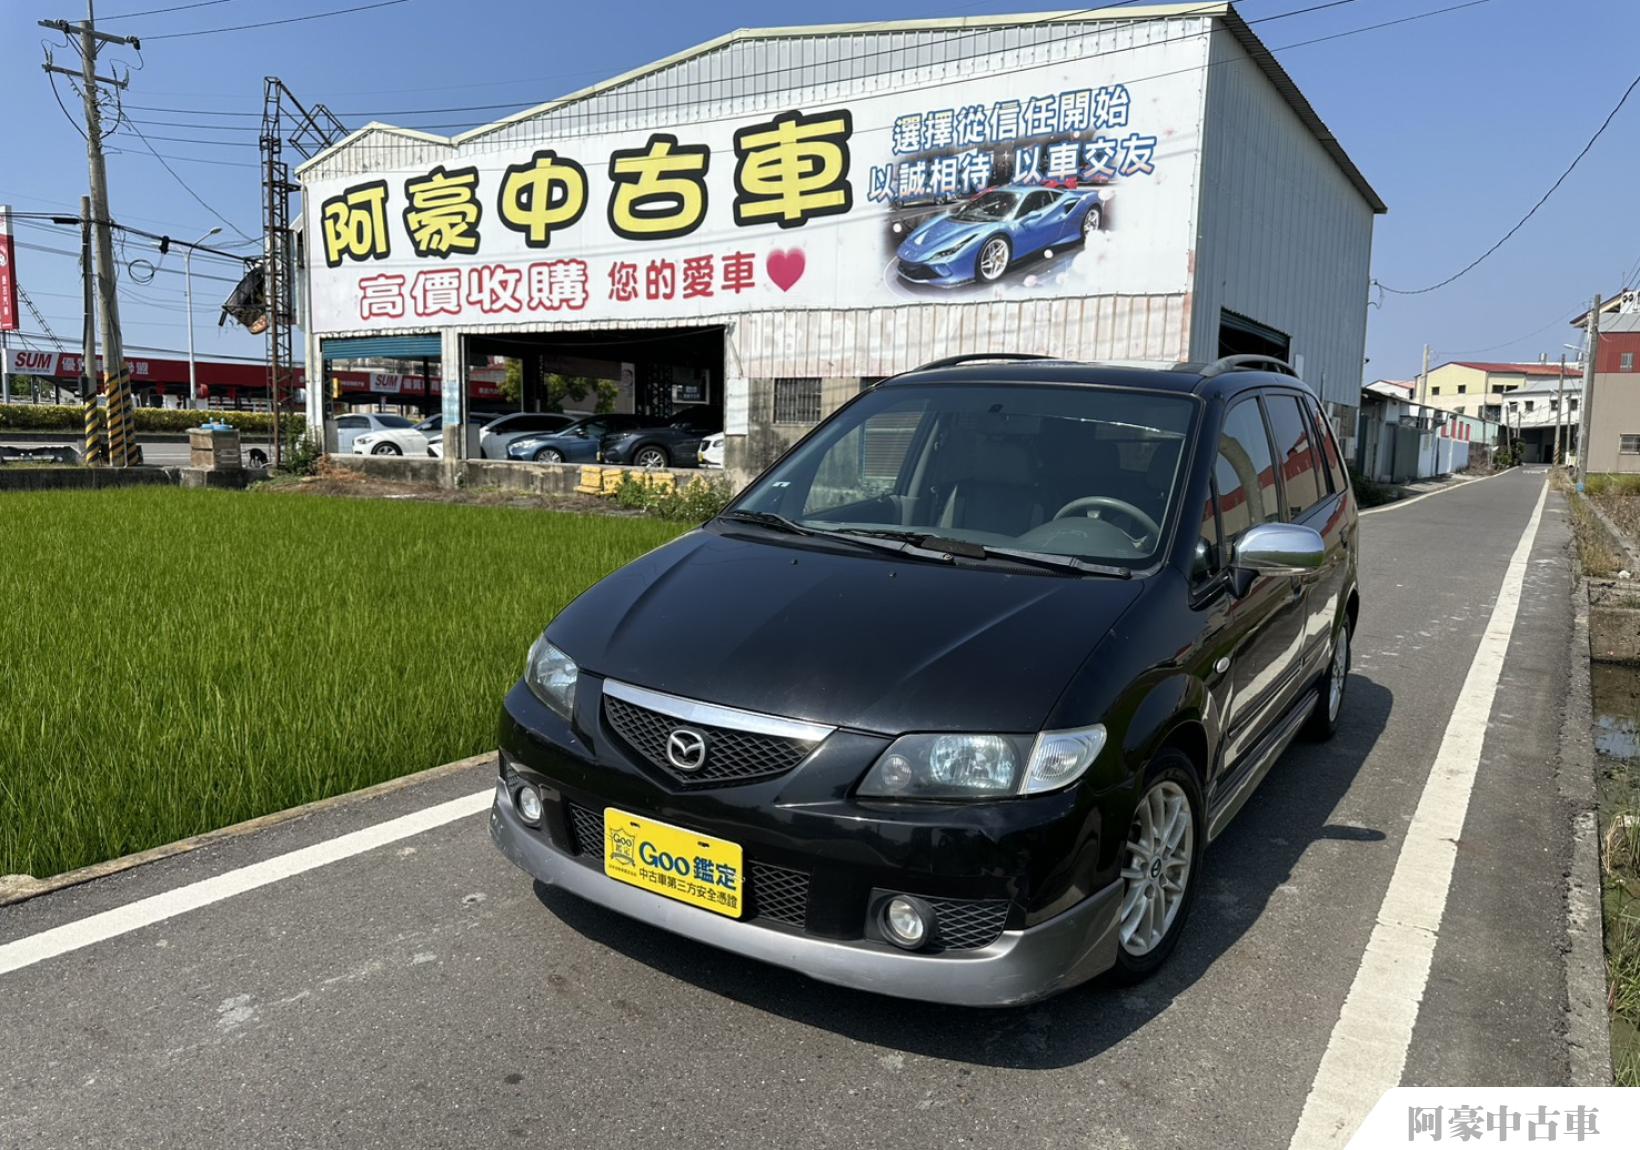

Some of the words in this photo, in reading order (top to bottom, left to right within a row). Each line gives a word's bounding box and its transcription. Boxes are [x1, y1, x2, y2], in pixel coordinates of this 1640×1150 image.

[892, 84, 1131, 155] 選擇從信任開始
[321, 110, 853, 267] 阿豪中古車
[867, 154, 991, 201] 以誠相待
[1011, 134, 1156, 185] 以車交友
[358, 258, 590, 320] 高價收購
[607, 250, 756, 301] 您的愛車
[15, 351, 52, 369] SUM
[375, 374, 398, 386] SUM
[613, 833, 632, 847] Goo
[639, 841, 690, 876] Goo
[693, 856, 737, 891] 鑑定
[639, 867, 737, 908] 中古車第三方安全憑證
